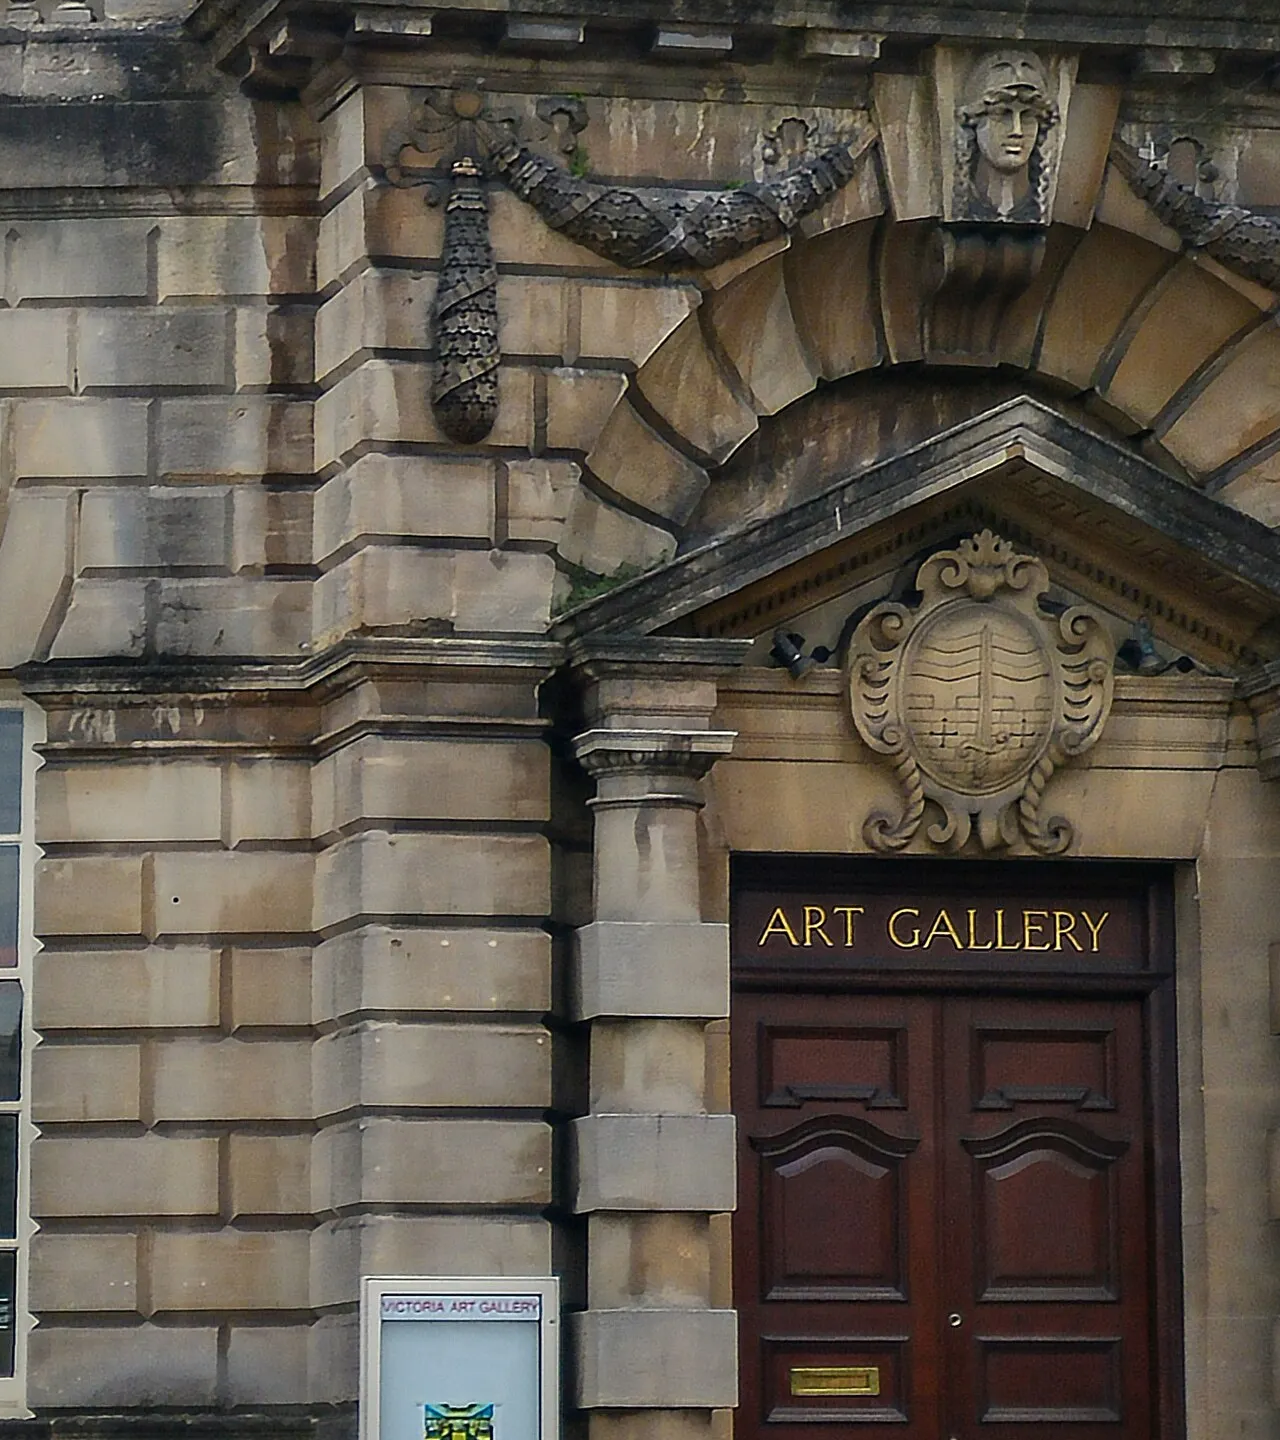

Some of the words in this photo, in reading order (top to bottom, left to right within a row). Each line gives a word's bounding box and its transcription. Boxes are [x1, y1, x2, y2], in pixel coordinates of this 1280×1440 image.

[758, 906, 864, 948] ART
[886, 908, 1110, 951] GALLERY
[383, 1301, 444, 1312] VICTORIA
[451, 1301, 476, 1312] ART
[480, 1302, 538, 1314] GALLERY
